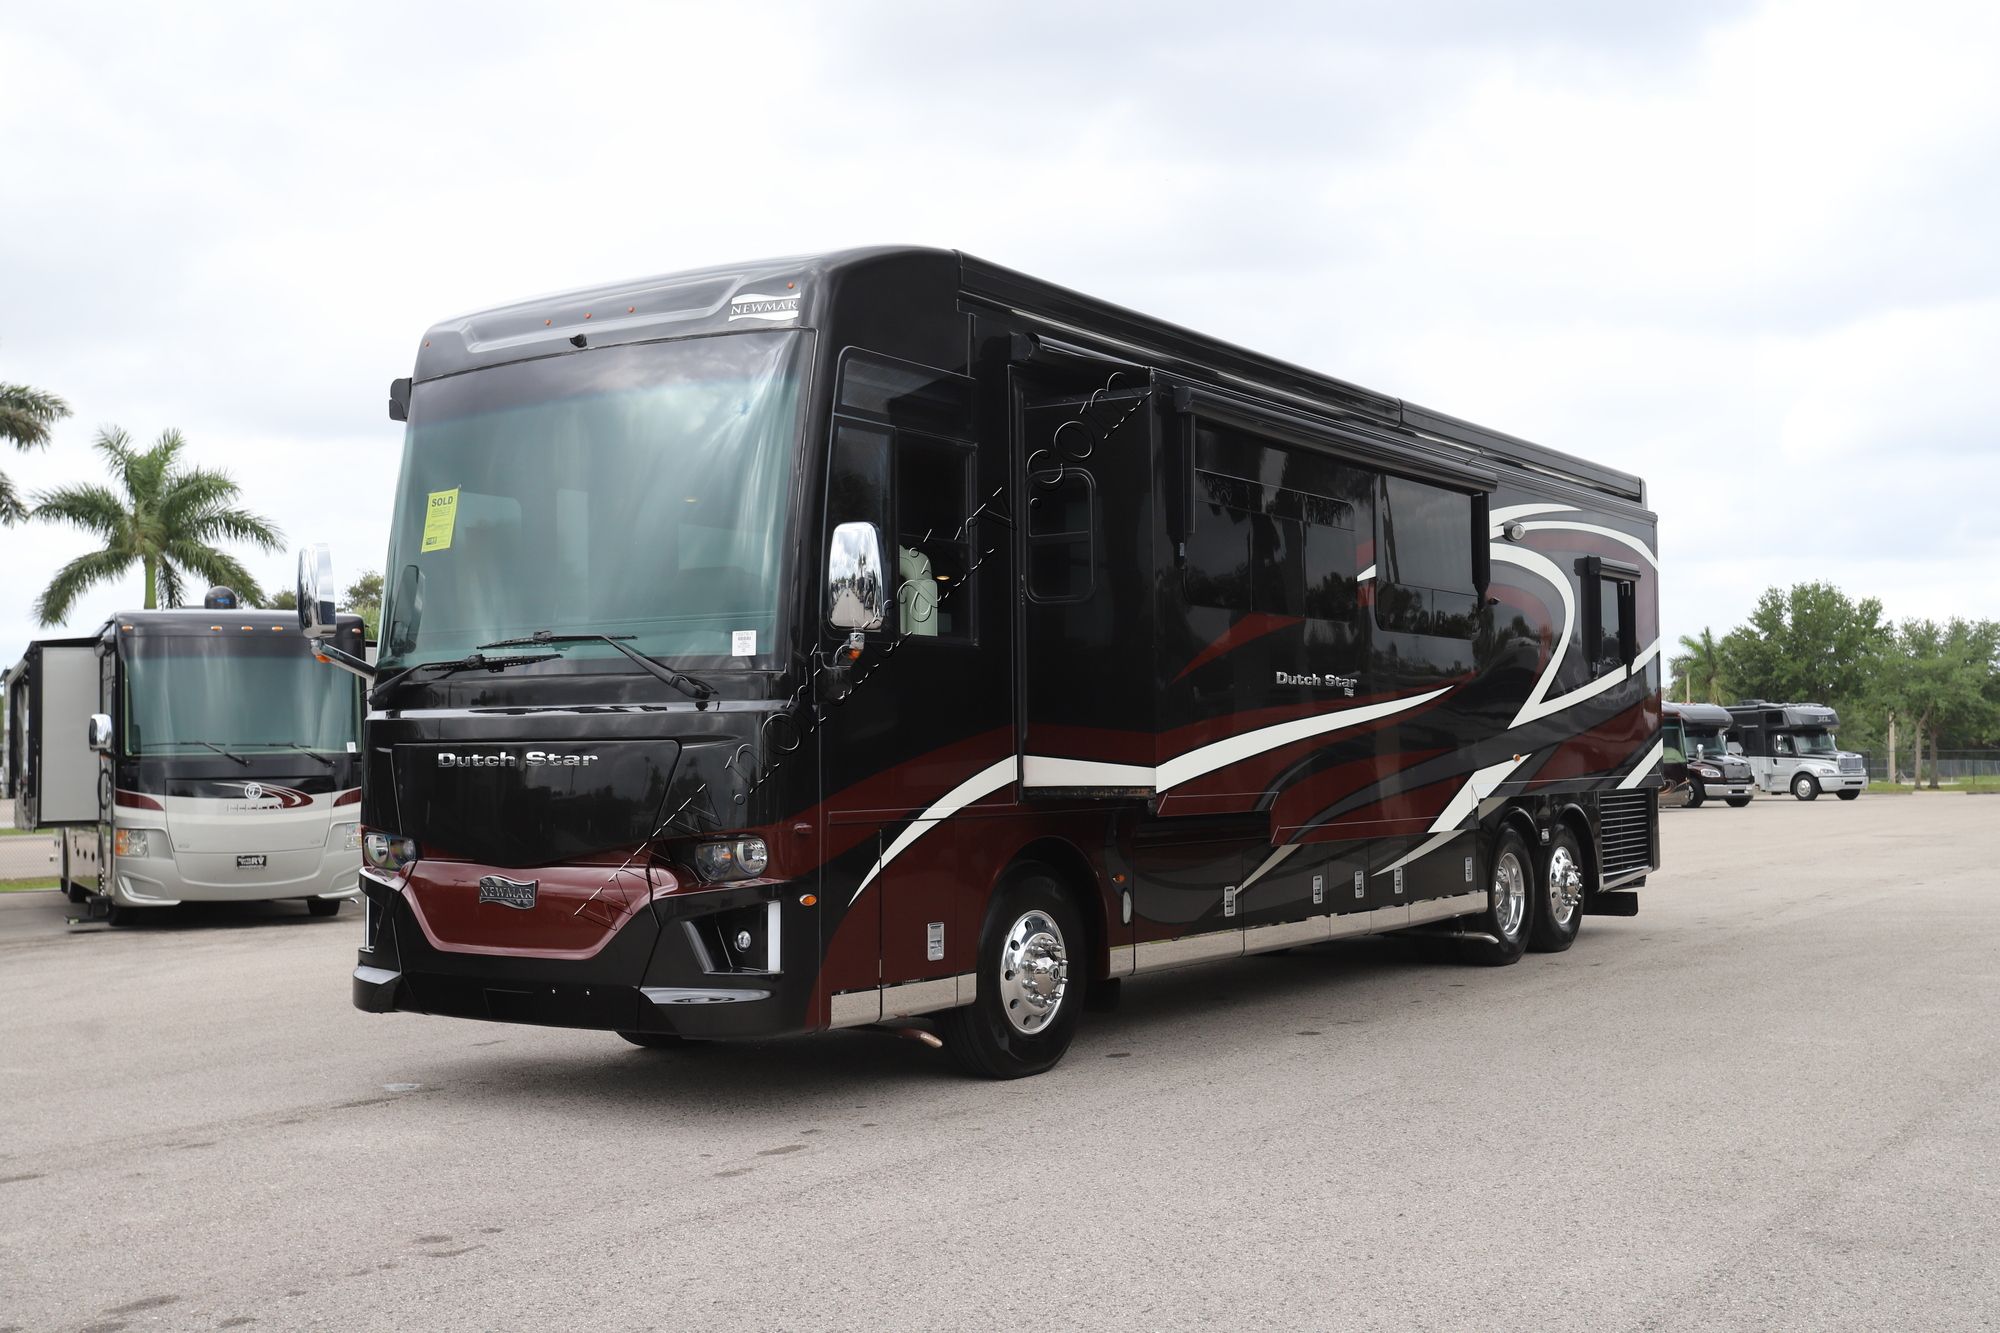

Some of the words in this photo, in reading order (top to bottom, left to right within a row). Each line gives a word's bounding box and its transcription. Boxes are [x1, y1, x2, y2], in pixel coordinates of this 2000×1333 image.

[731, 300, 798, 315] NEWMAR
[432, 496, 454, 507] SOLD
[1276, 671, 1321, 686] Dutch
[1325, 674, 1358, 688] Star
[437, 752, 516, 767] Dutch
[525, 751, 599, 767] Star
[252, 857, 264, 865] RV
[480, 886, 533, 898] NEWMAR
